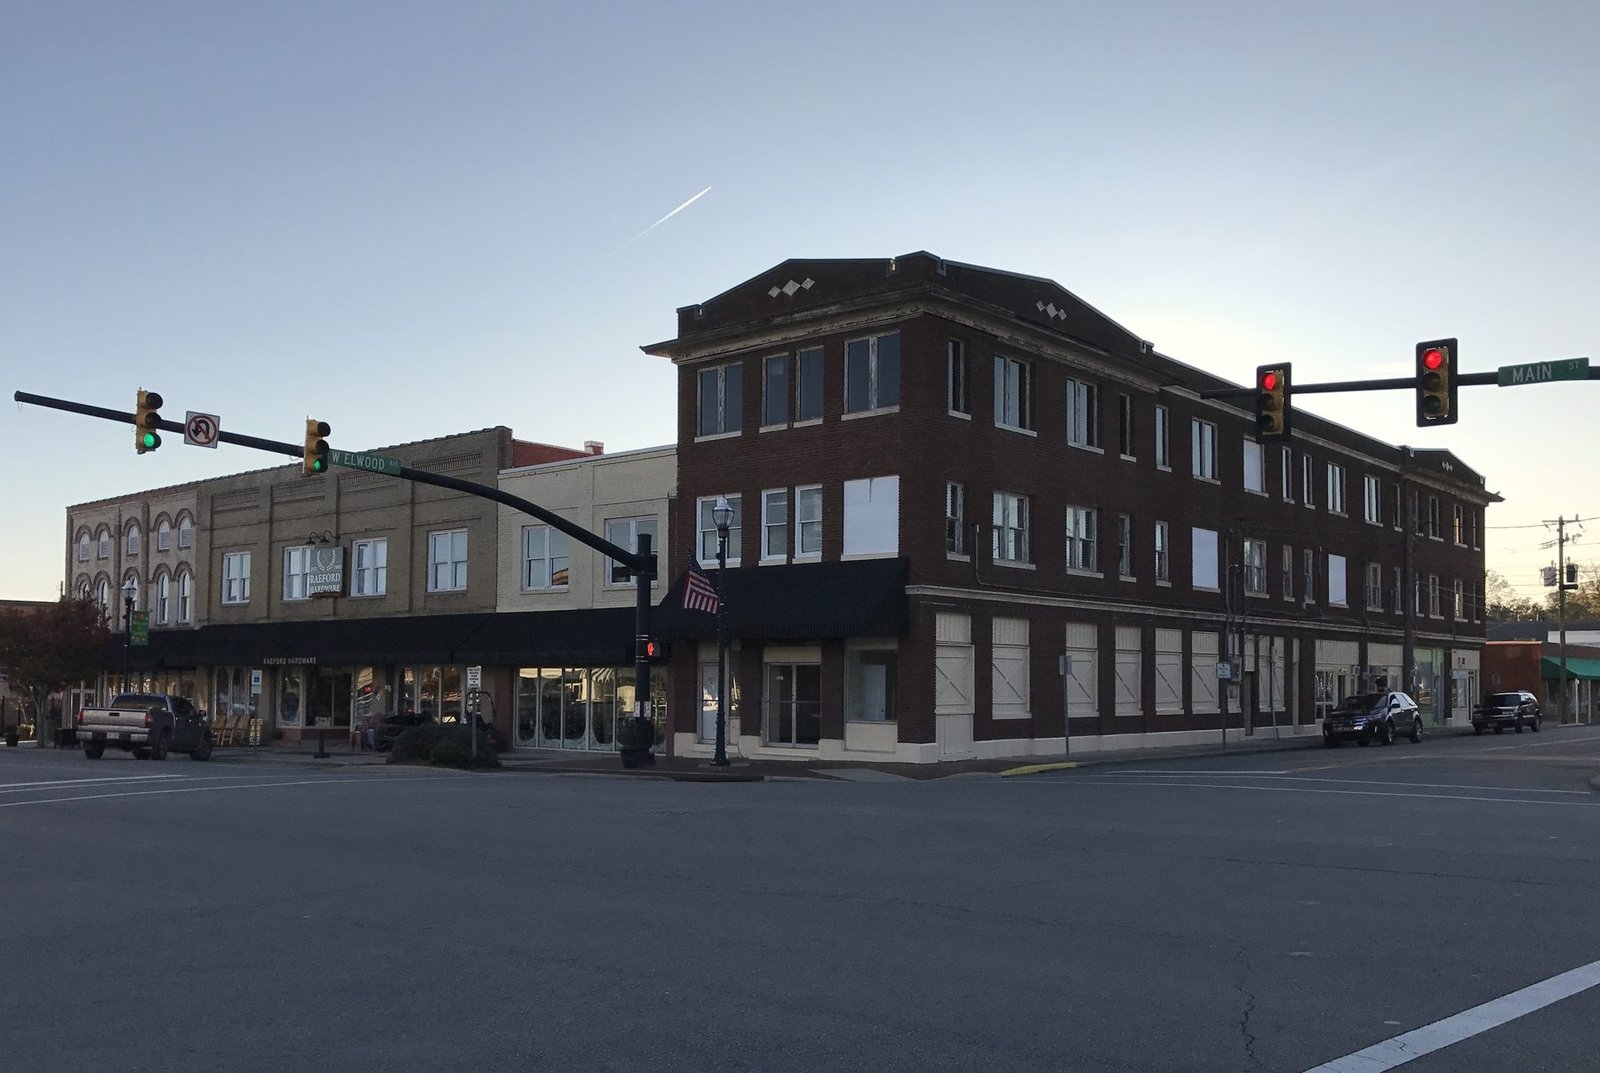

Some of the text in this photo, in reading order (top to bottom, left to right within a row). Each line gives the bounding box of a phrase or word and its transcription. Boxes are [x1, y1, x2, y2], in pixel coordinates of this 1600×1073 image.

[1512, 361, 1579, 383] MAIN ST
[331, 451, 340, 463] W
[344, 453, 385, 470] ELWOOD
[310, 573, 341, 583] RAEFORD
[310, 584, 341, 594] HARDWARE
[263, 656, 317, 665] RAEFORD HARDWARE
